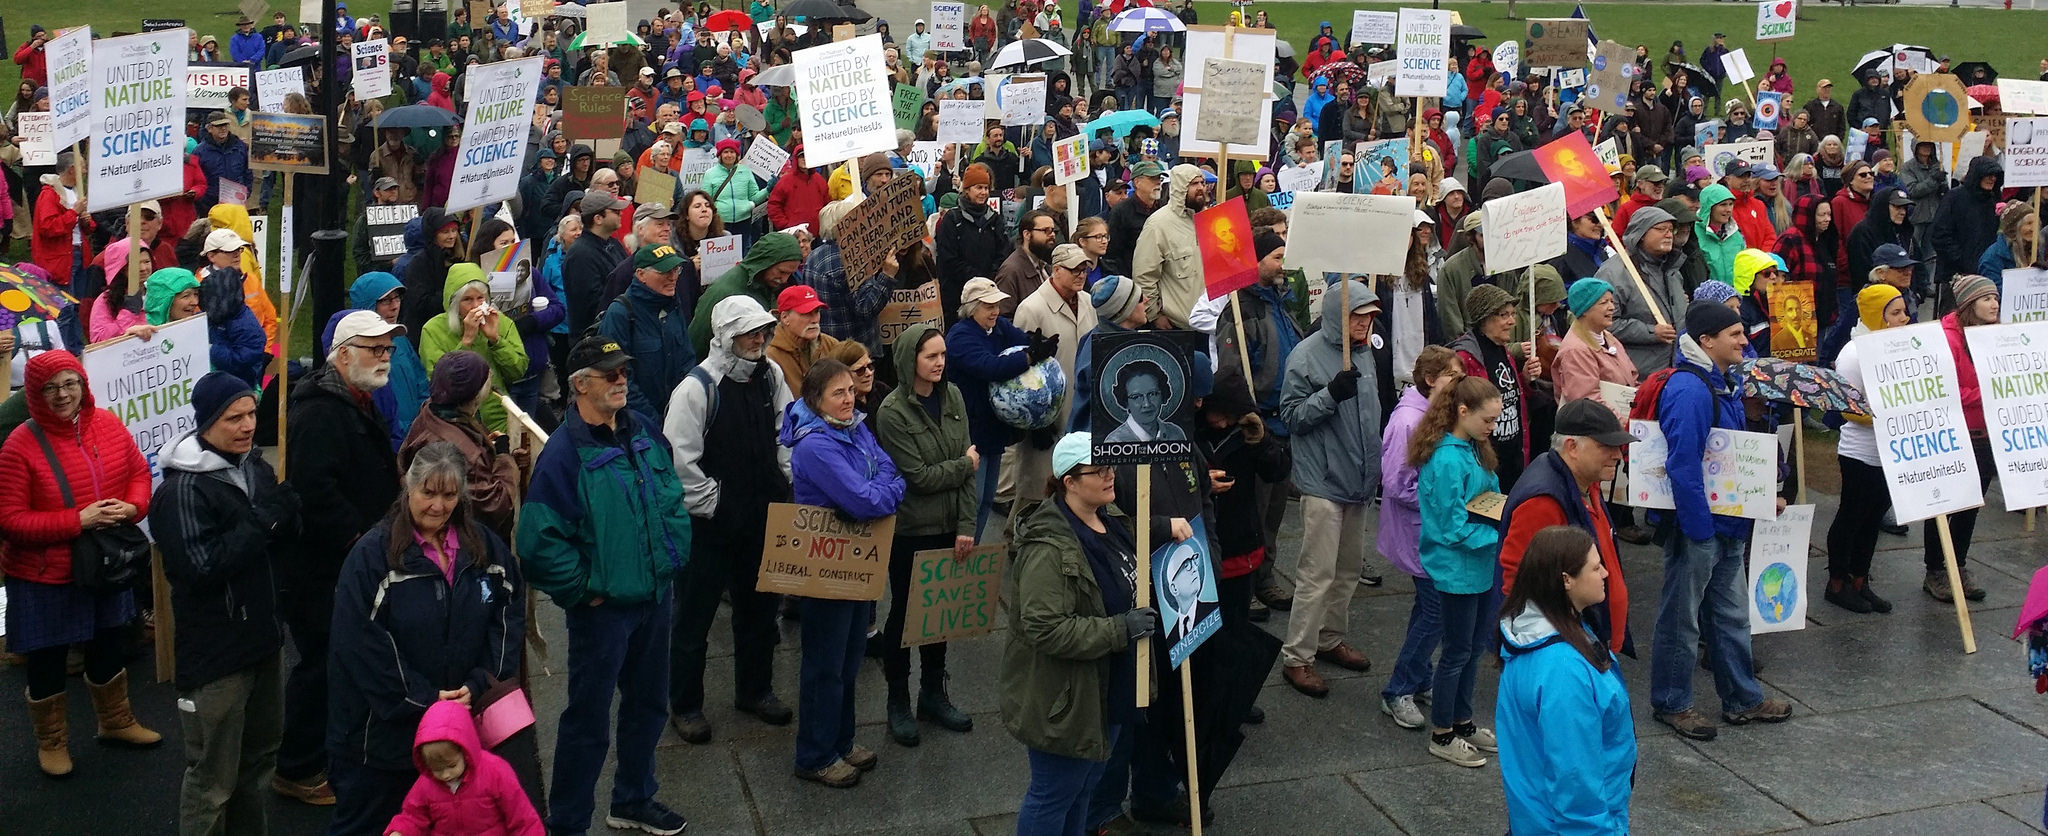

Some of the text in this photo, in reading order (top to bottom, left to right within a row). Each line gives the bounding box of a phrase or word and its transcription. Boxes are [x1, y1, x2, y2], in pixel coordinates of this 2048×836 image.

[1764, 5, 1771, 18] I
[1407, 24, 1442, 33] UNITED BY
[1760, 21, 1793, 36] SCIENCE
[356, 43, 383, 56] Science
[937, 41, 956, 49] REAL
[1405, 48, 1441, 57] GUIDED BY
[54, 60, 88, 86] NATURE
[107, 58, 174, 84] UNITED BY
[260, 70, 303, 86] SCIENCE
[808, 55, 870, 79] UNITED BY
[105, 78, 176, 108] NATURE.
[479, 82, 529, 105] UNITED BY
[809, 68, 876, 95] NATURE.
[1006, 86, 1042, 98] Science
[56, 90, 90, 117] SCIENCE
[570, 88, 622, 101] Science
[811, 87, 875, 112] GUIDED BY
[900, 89, 920, 102] FREE
[900, 101, 914, 110] THE
[580, 101, 612, 113] Rules
[812, 100, 882, 128] SCIENCE.
[893, 109, 917, 120] DATA!
[24, 123, 53, 133] FACTS
[104, 105, 173, 134] GUIDED BY
[814, 121, 883, 142] #NatureUnitesUs
[102, 125, 174, 158] SCIENCE.
[470, 123, 521, 147] GUIDED BY
[100, 155, 172, 177] #NatureUnitesUs
[2014, 158, 2047, 167] SCIENCE
[459, 165, 514, 185] #NatureUnitesUs
[685, 172, 704, 186] NAT
[838, 174, 913, 233] HOW MANY TIMES
[867, 203, 892, 228] MAN
[889, 189, 917, 210] TURN
[1270, 190, 1294, 206] EVELS
[1337, 195, 1375, 207] SCIENCE
[845, 205, 913, 262] HIS HEAD AND
[847, 214, 917, 274] PRETEND THAT HE
[900, 221, 925, 247] SEE?
[653, 246, 677, 258] UVM
[706, 238, 734, 255] Proud
[889, 286, 937, 303] NORANCE
[1771, 347, 1816, 359] REGENERATE
[1986, 355, 2031, 375] UNITED
[107, 353, 192, 402] UNITED BY
[1875, 353, 1939, 383] UNITED BY
[1879, 375, 1950, 409] NATURE.
[1887, 406, 1950, 437] GUIDED BY
[1998, 404, 2042, 430] GUIDED
[133, 423, 174, 453] IDED
[1093, 443, 1140, 457] SHOOT
[1147, 443, 1191, 455] MOON
[1890, 427, 1963, 463] SCIENCE.
[2003, 426, 2048, 453] SCIEN
[1898, 460, 1967, 484] #NatureUnitesUs
[2008, 456, 2048, 473] #NatureU
[776, 535, 878, 562] IS NOT A
[766, 560, 874, 584] LIBERAL CONSTRUCT
[920, 553, 996, 586] SCIENCE
[922, 581, 987, 608] SAVES
[922, 601, 988, 639] LIVES
[1170, 611, 1221, 661] SYNERGIZE
